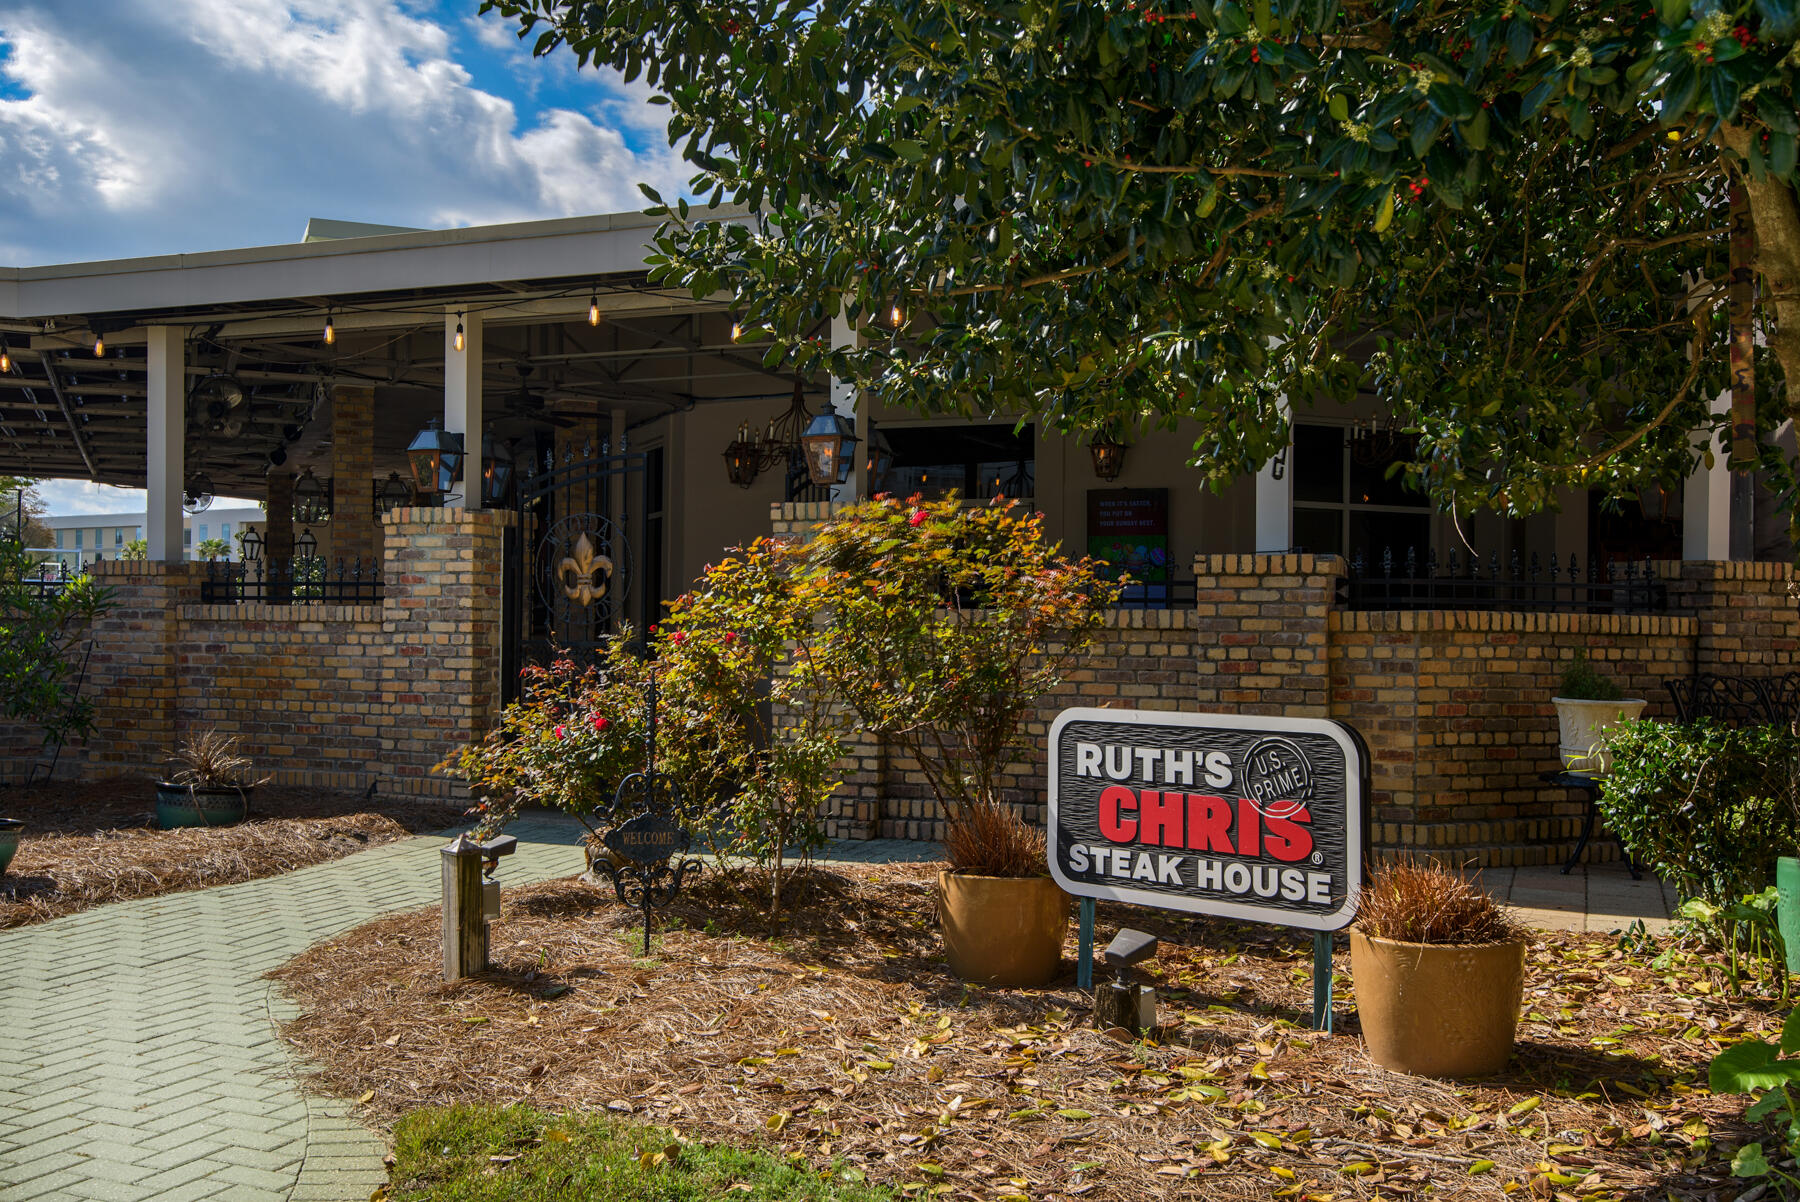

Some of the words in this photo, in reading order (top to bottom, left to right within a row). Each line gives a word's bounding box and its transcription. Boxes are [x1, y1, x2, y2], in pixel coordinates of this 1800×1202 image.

[1076, 743, 1234, 789] RUTH'S
[1256, 751, 1287, 776] U.S.
[1254, 766, 1305, 803] PRIME
[623, 831, 675, 846] WELCOME
[1099, 786, 1314, 862] CHRIS
[1069, 843, 1184, 886] STEAK
[1198, 859, 1332, 905] HOUSE
